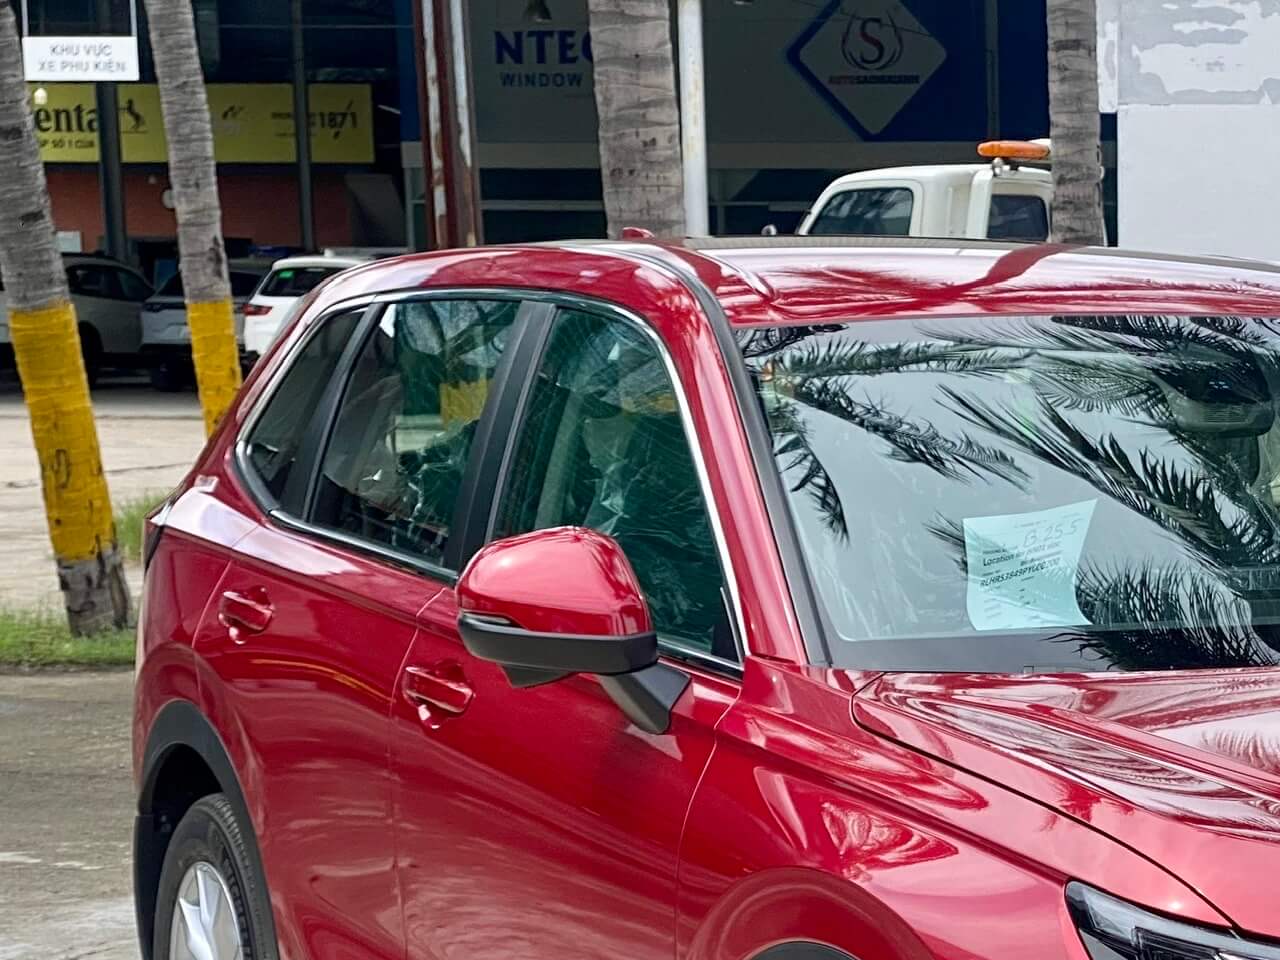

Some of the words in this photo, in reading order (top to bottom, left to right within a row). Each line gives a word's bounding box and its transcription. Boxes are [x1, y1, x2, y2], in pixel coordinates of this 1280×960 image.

[50, 43, 80, 56] KHU
[38, 61, 56, 72] XE
[502, 71, 584, 88] WINDOW
[34, 104, 97, 132] enta
[318, 111, 358, 129] 1871
[983, 553, 1015, 567] Location
